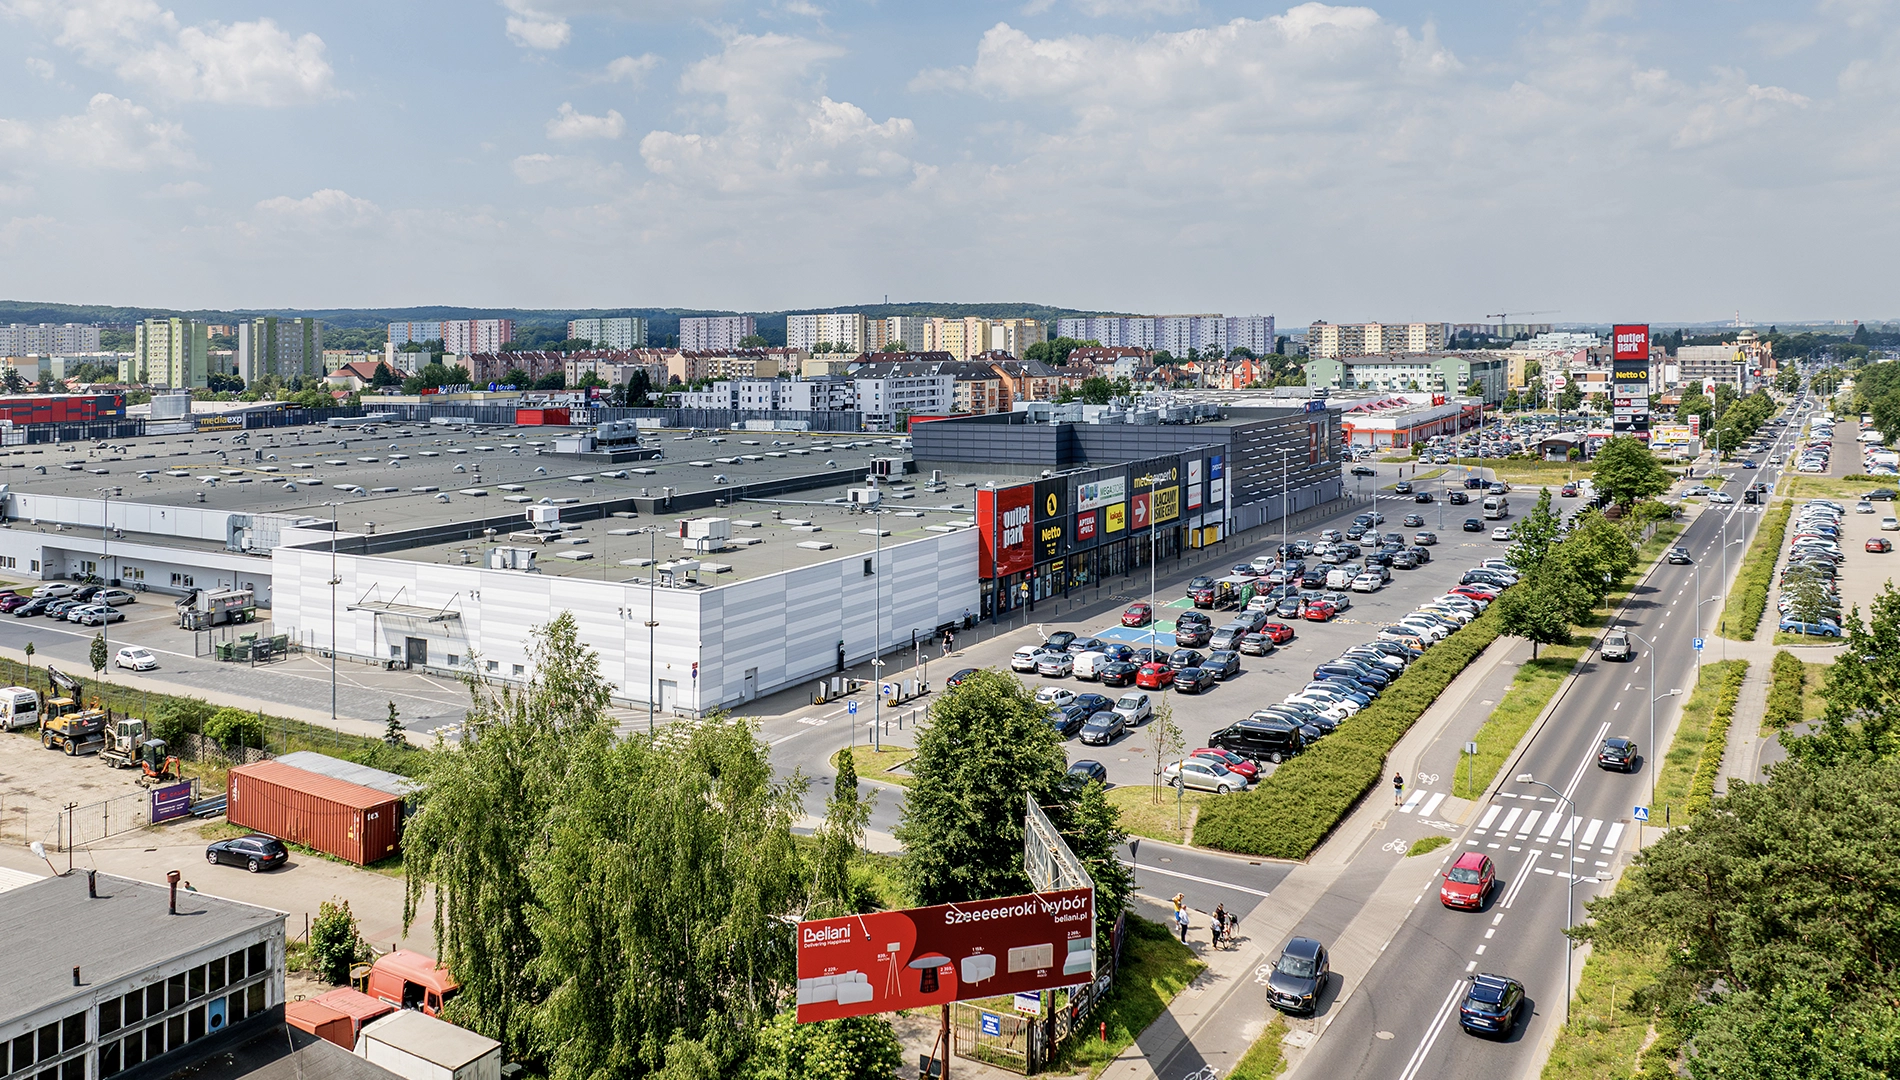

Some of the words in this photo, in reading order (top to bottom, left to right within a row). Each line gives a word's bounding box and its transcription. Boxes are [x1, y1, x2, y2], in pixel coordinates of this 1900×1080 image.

[1617, 333, 1645, 345] outlet
[1617, 343, 1638, 352] park
[1616, 371, 1638, 379] Netto
[1003, 505, 1030, 528] outlet
[1003, 525, 1024, 548] park
[1042, 526, 1061, 541] Netto
[945, 900, 1036, 925] Szeeeeeroki
[1041, 895, 1087, 915] wybór
[1054, 911, 1088, 923] beliani.pl
[803, 923, 851, 943] Beliani
[804, 941, 827, 949] Delivering
